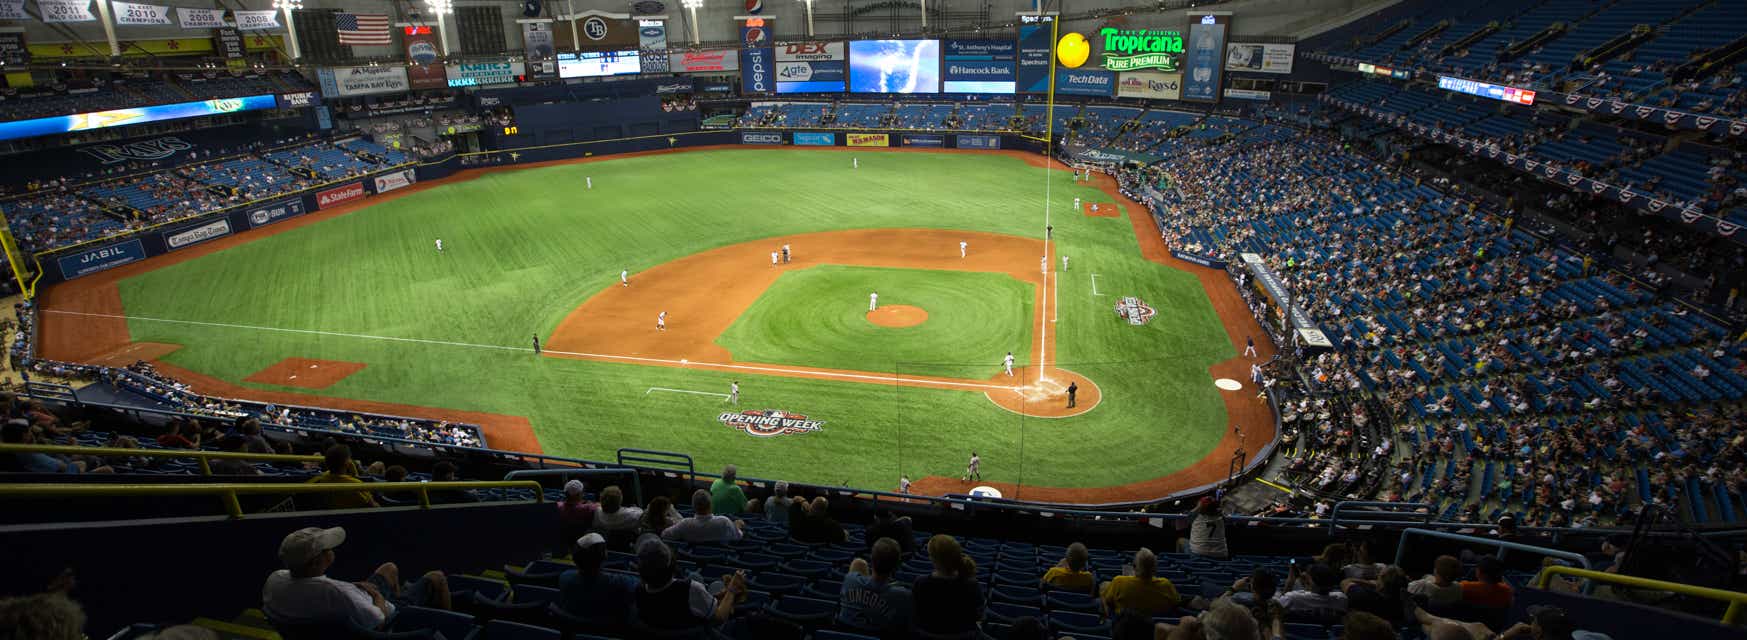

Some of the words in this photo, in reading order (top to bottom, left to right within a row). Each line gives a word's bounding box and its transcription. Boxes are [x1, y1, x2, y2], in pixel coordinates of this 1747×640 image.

[53, 6, 79, 14] 2011
[127, 9, 157, 18] 2010
[120, 16, 165, 24] CHAMPIONS
[588, 21, 604, 36] TB
[1101, 28, 1183, 54] Tropicana
[785, 43, 829, 54] DEX
[1107, 56, 1129, 68] PURE
[1130, 55, 1170, 67] PREMIUM
[750, 51, 766, 92] pepsi
[958, 66, 990, 74] Hancock
[991, 66, 1010, 74] Bank
[744, 134, 780, 142] GEICO
[81, 247, 125, 264] JABIL
[720, 413, 779, 427] OPENING
[780, 417, 824, 431] WEEK
